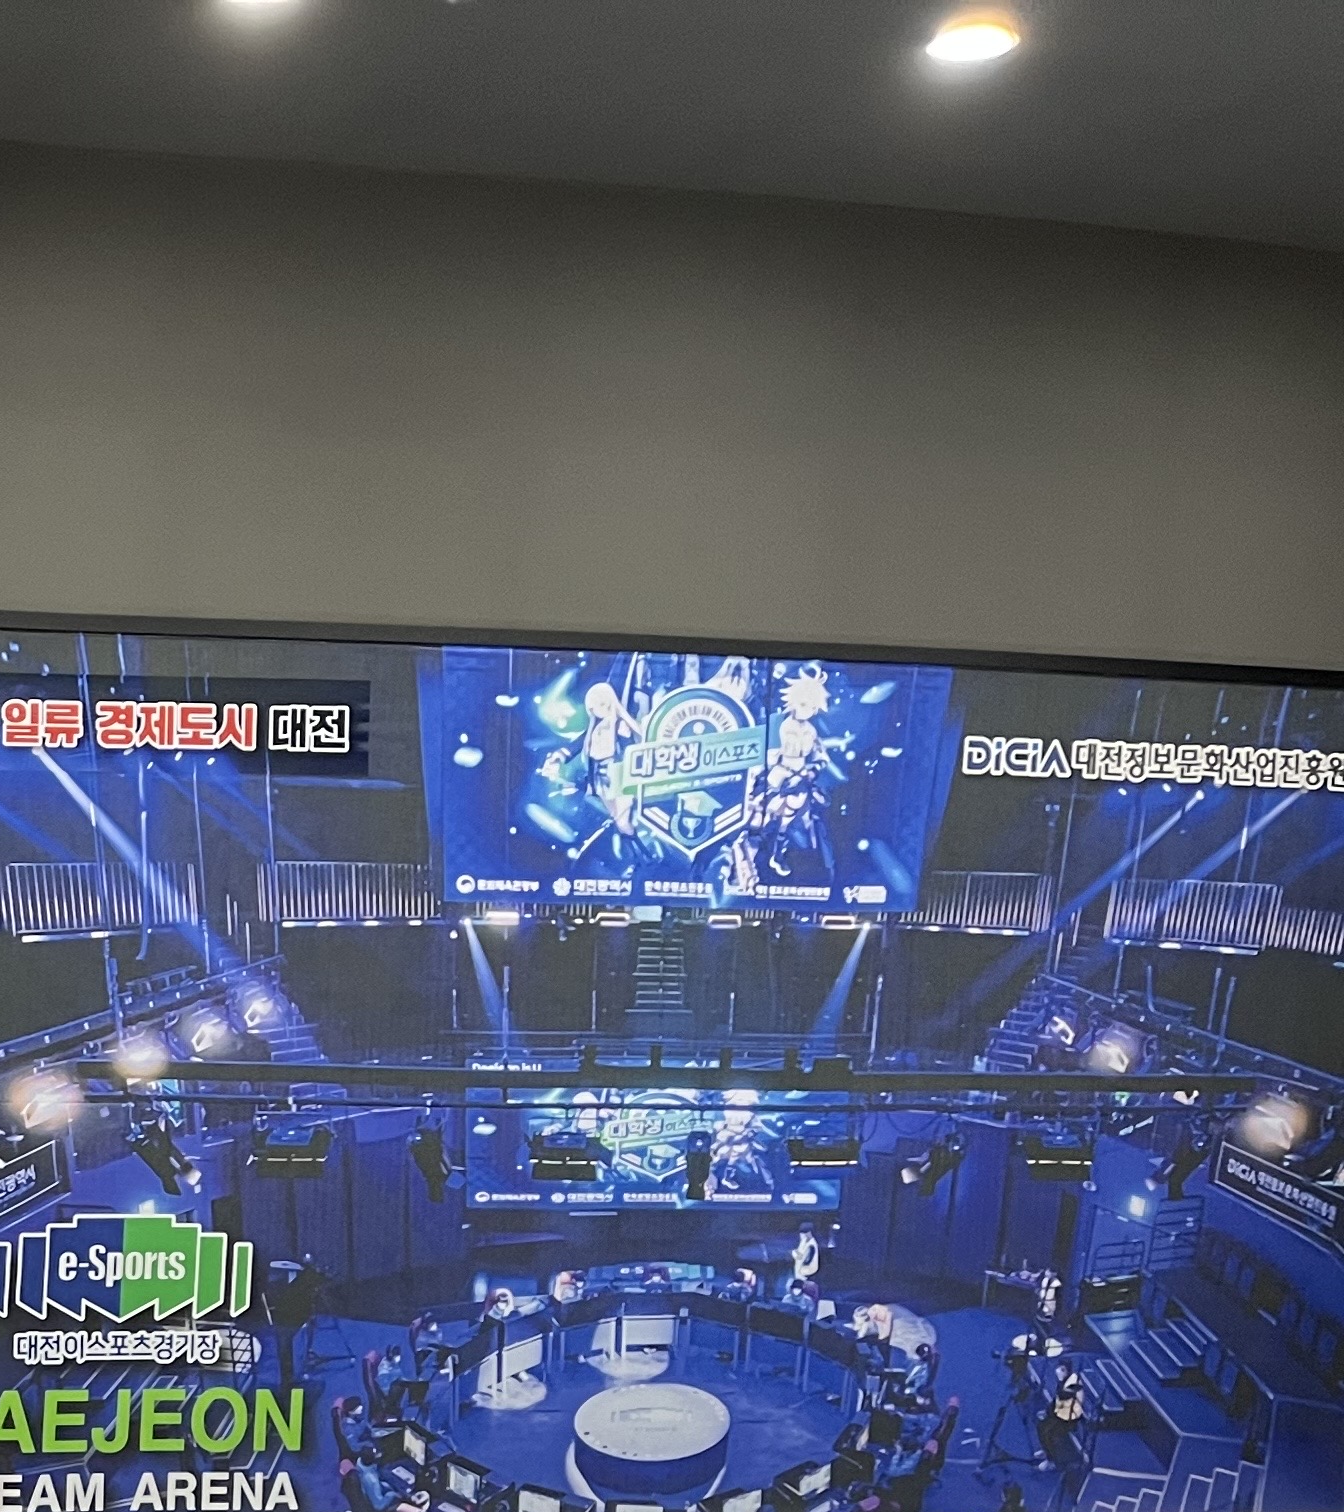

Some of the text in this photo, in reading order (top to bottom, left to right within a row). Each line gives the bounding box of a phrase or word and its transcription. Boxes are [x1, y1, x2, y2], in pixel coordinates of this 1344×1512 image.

[5, 702, 80, 744] 일류
[100, 705, 254, 747] 경제도시
[273, 708, 348, 748] 대전
[630, 741, 702, 778] 대학생
[58, 1245, 185, 1287] e-Sports
[17, 1334, 219, 1361] 대전이스포츠경기장
[130, 1472, 299, 1512] ARENA
